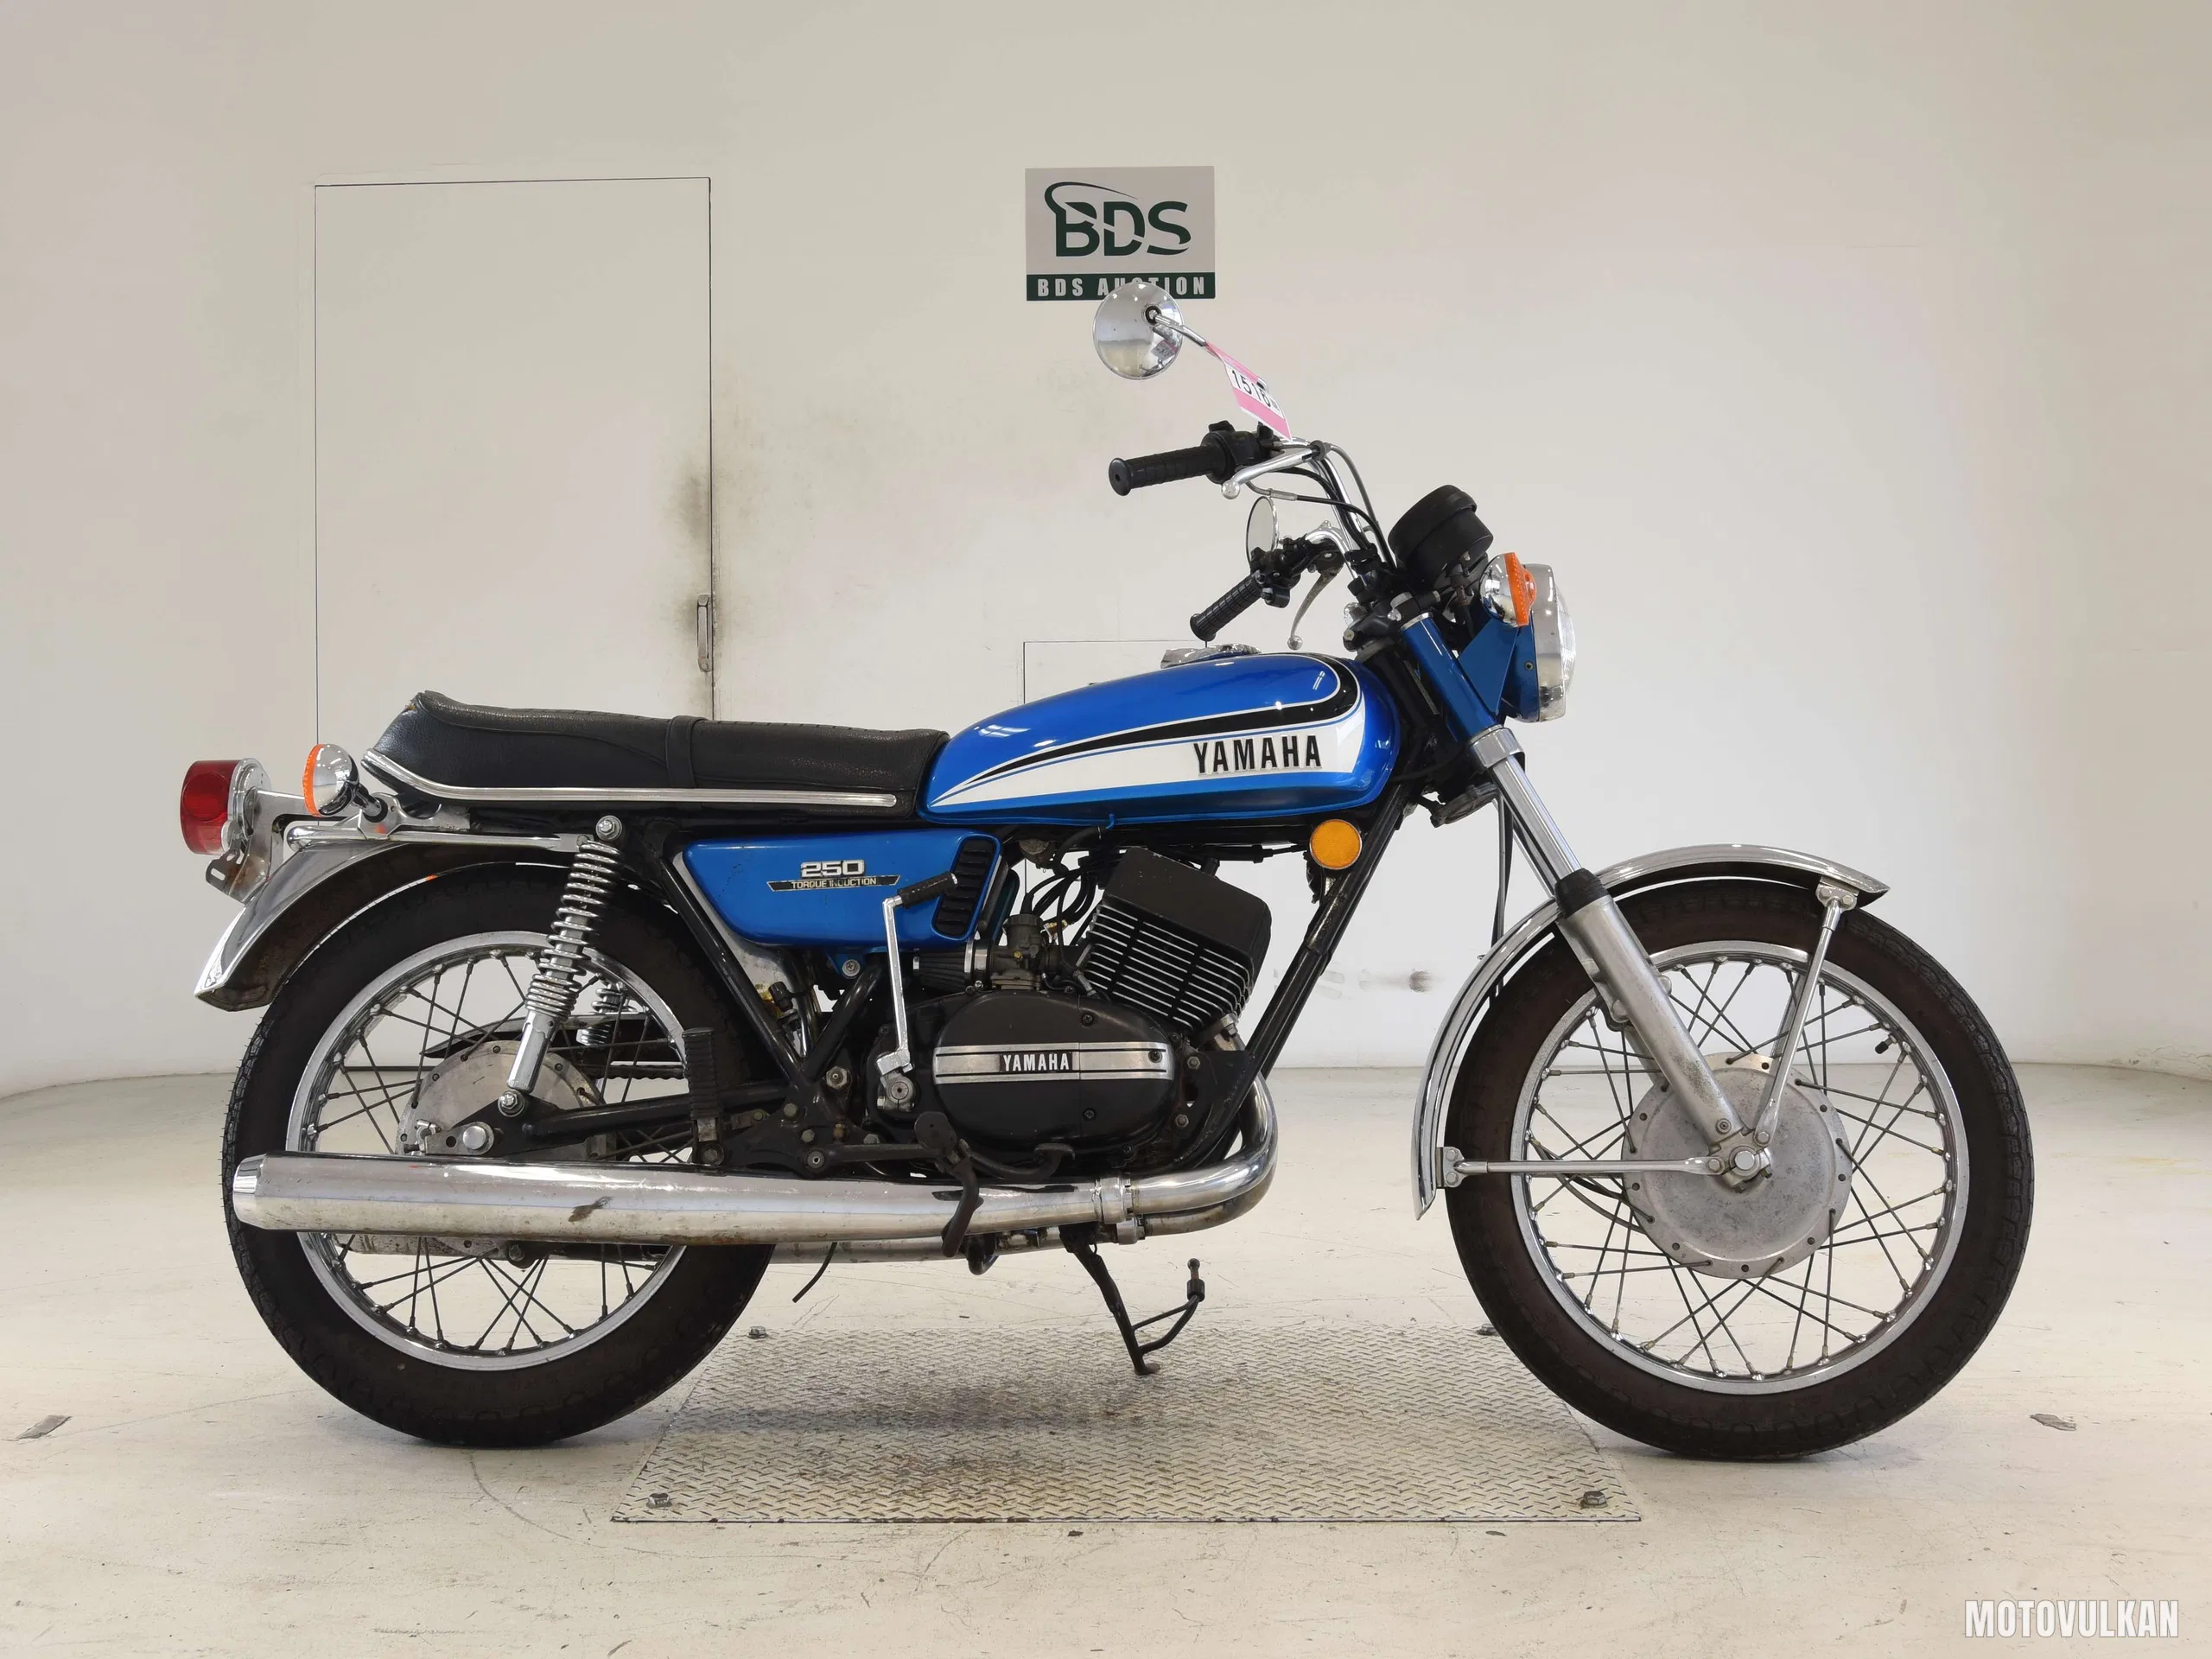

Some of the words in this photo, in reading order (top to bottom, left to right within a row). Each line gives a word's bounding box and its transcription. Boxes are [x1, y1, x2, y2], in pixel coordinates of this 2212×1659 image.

[1045, 181, 1192, 257] BDS
[1038, 278, 1083, 296] BDS
[1193, 734, 1322, 774] YAMAHA
[801, 859, 865, 878] 250
[791, 880, 827, 889] TORQUE
[1002, 1052, 1070, 1071] YAMAHA
